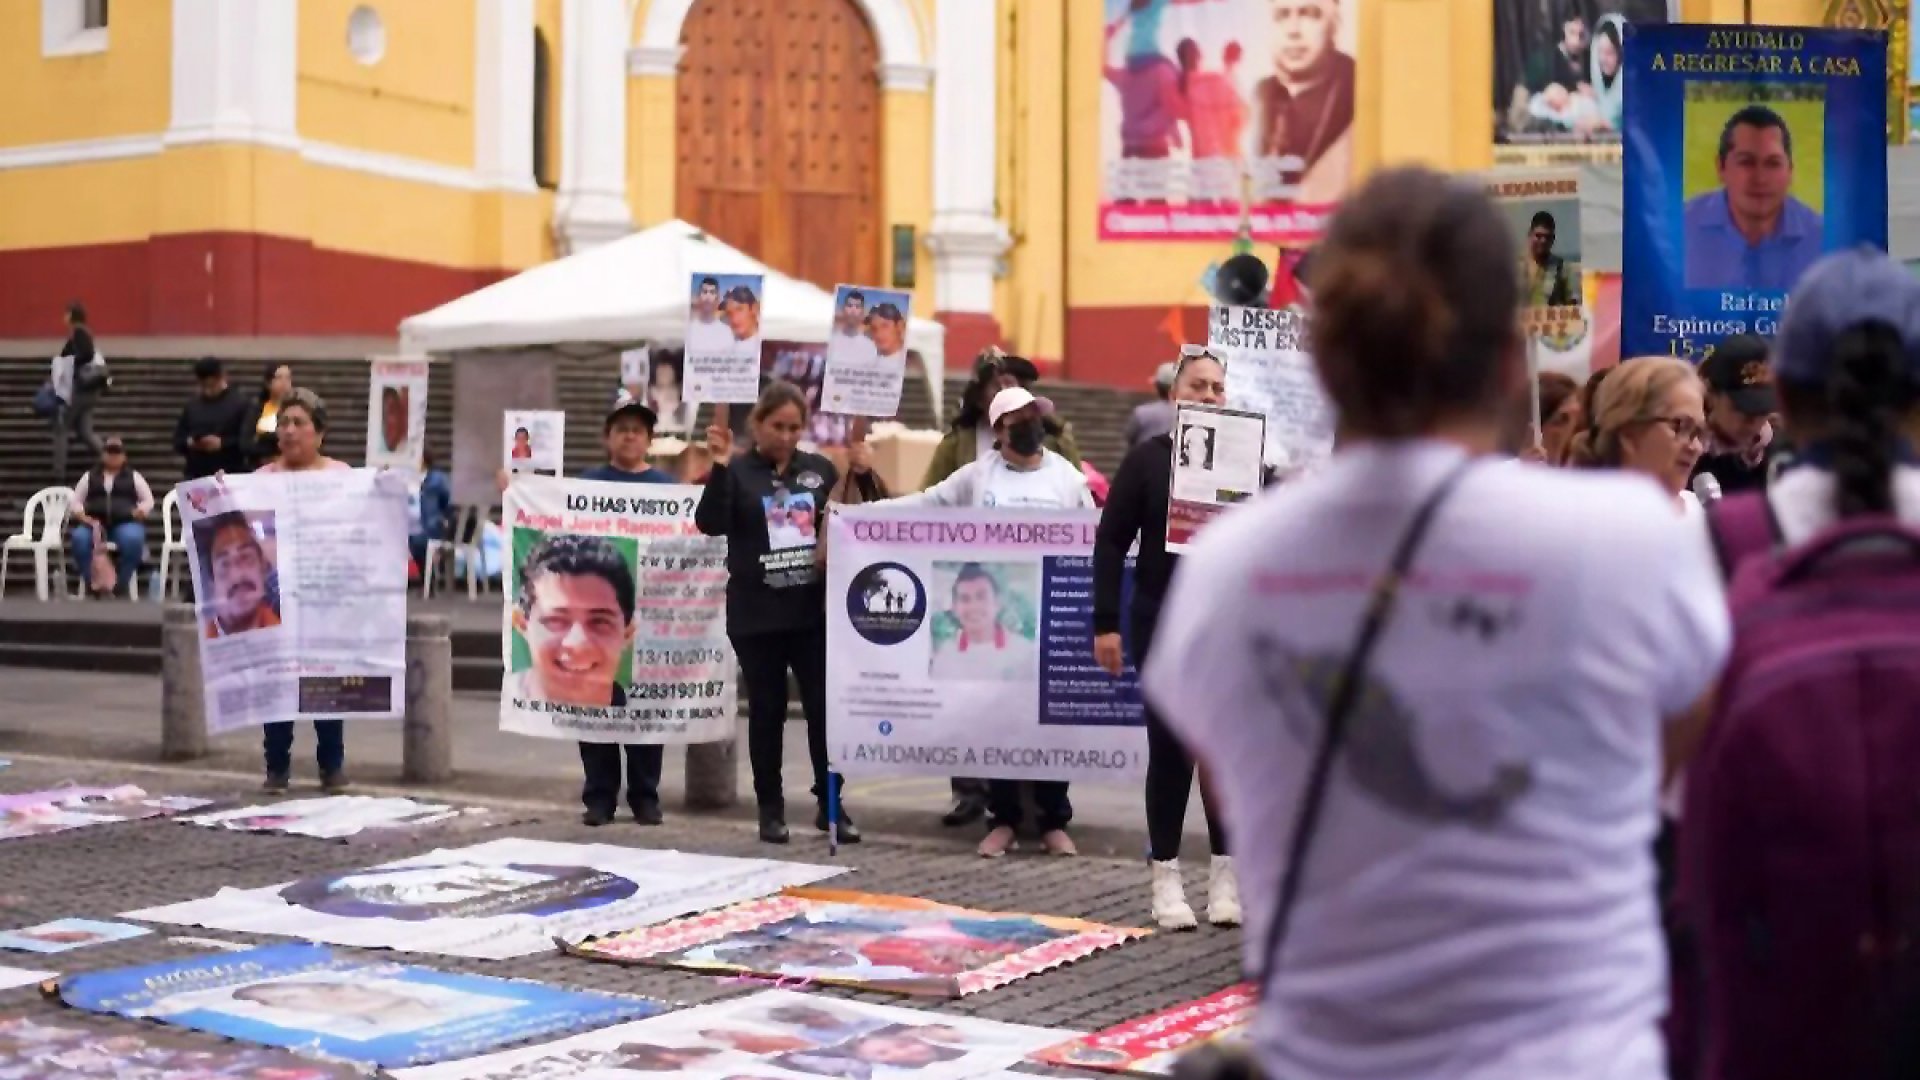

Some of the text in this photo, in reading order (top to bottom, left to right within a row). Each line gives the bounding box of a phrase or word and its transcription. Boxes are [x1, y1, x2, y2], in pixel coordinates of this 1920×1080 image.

[1706, 31, 1804, 50] AYUDALO
[1651, 53, 1861, 76] A REGRESAR A CASA
[1720, 292, 1791, 312] Rafael
[1653, 314, 1747, 338] Espinosa
[567, 494, 694, 516] LO HAS VISTO ?
[515, 508, 562, 530] Angel
[854, 521, 977, 544] COLECTIVO
[984, 522, 1073, 545] MADRES
[854, 743, 958, 766] AYUDANOS
[963, 747, 977, 765] A
[984, 748, 1126, 769] ENCONTRARLO
